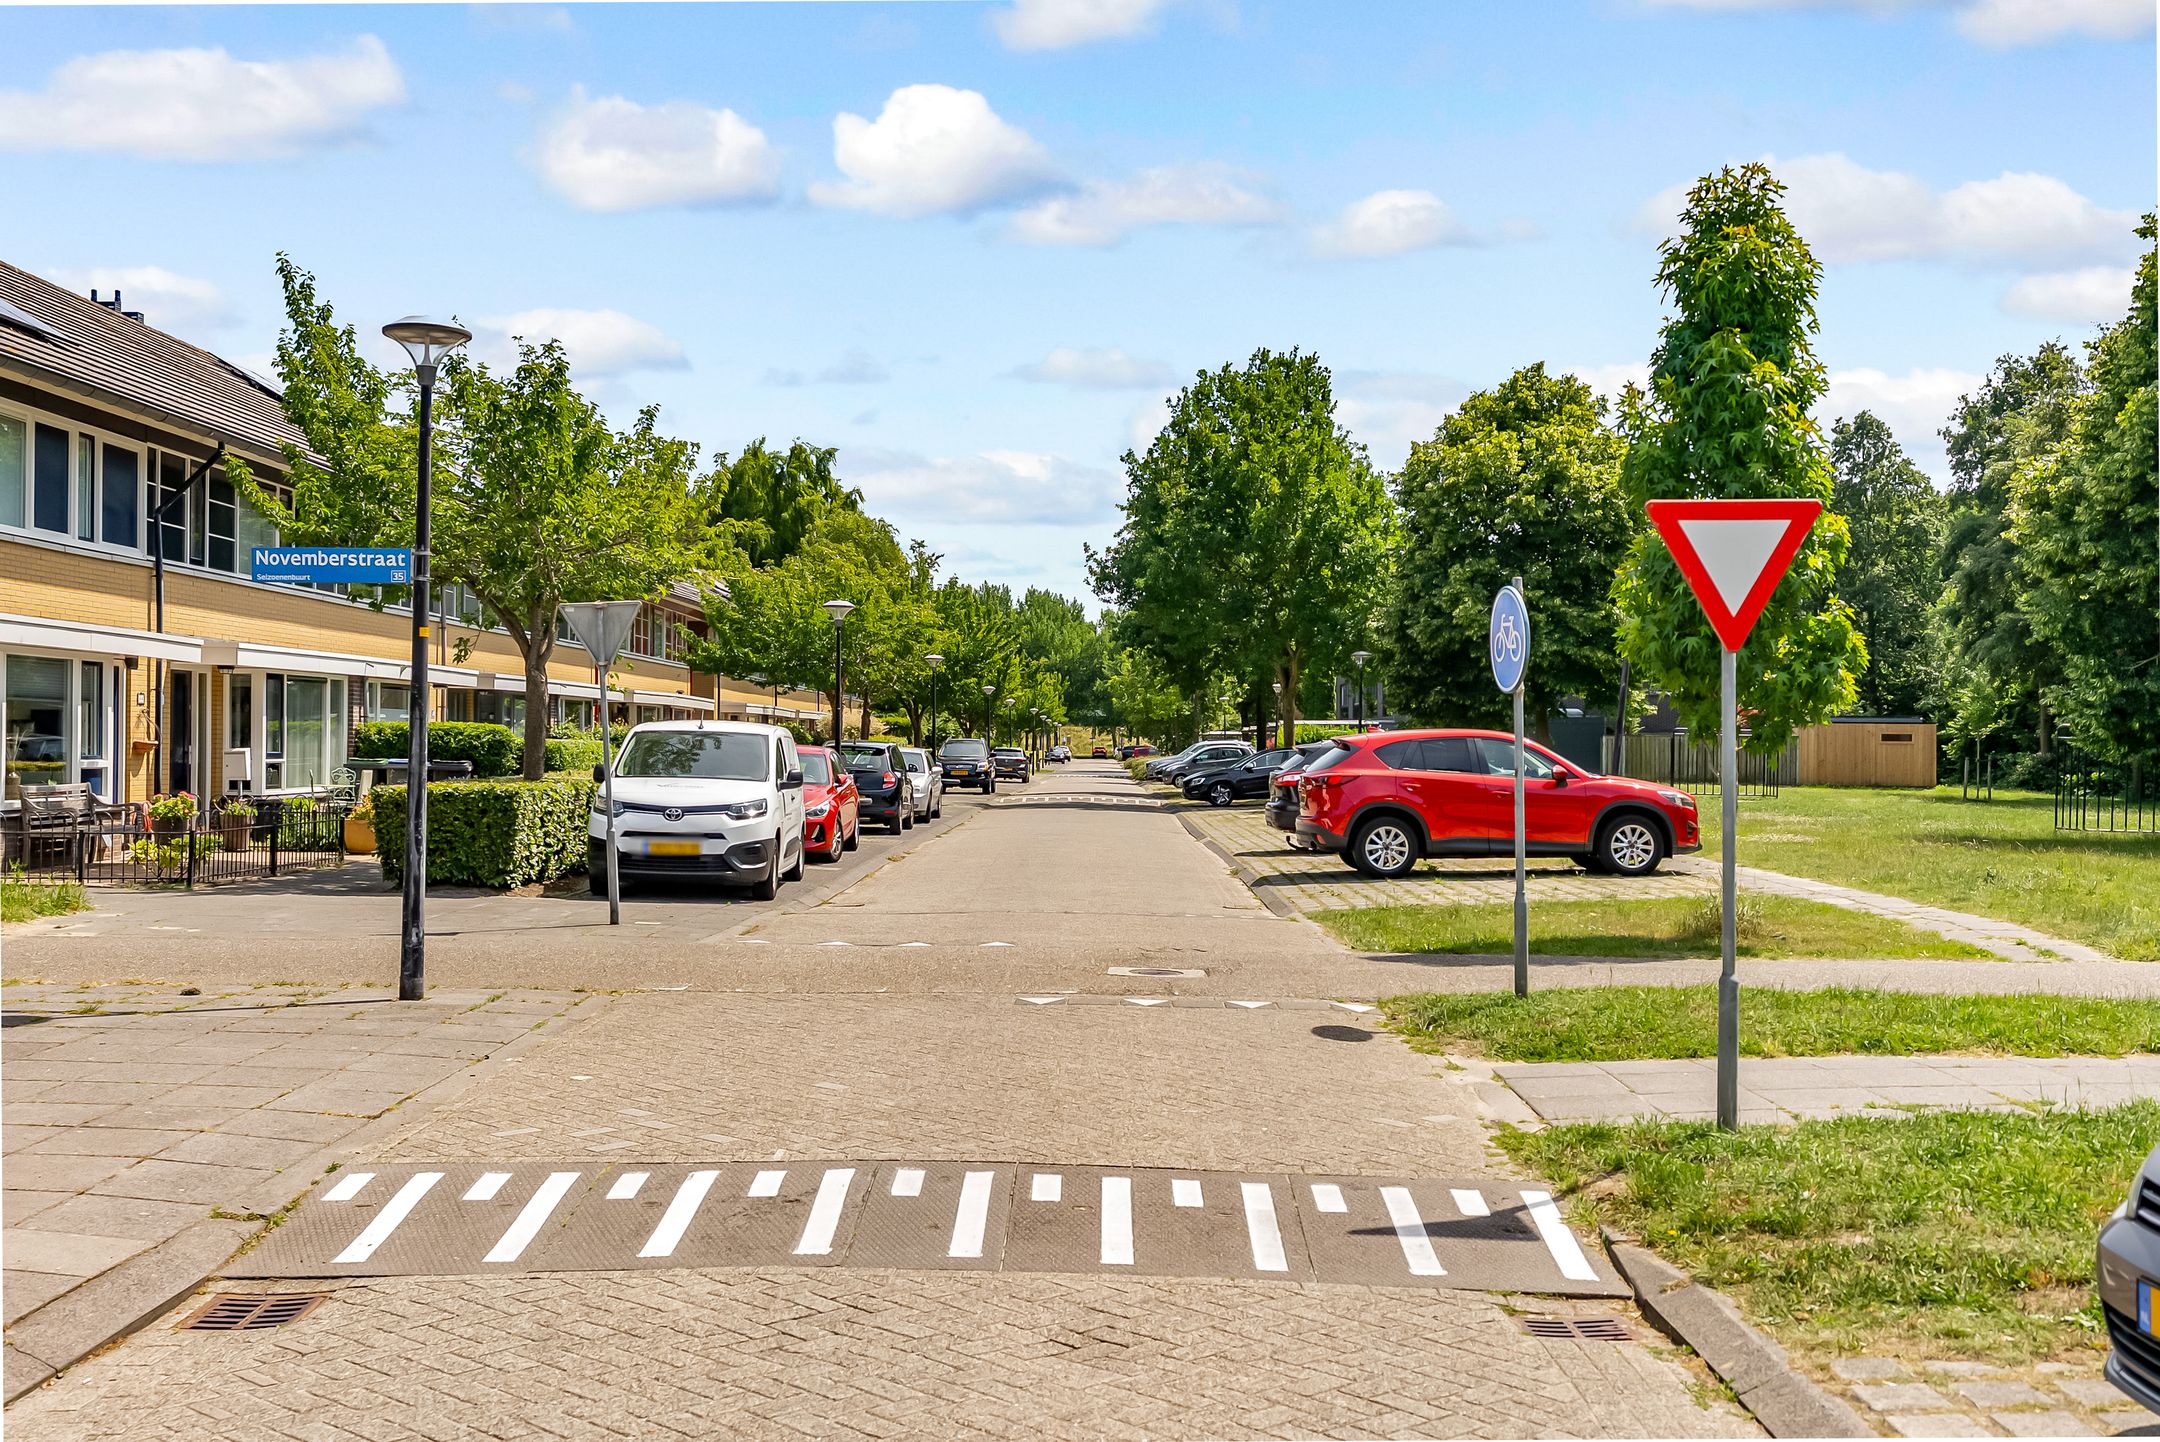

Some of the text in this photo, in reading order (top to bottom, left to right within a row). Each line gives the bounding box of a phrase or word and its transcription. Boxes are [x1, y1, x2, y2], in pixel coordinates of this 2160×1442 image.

[255, 550, 406, 566] Novemberstraat
[256, 573, 311, 581] Seizoenenbuurt
[392, 572, 404, 581] 35
